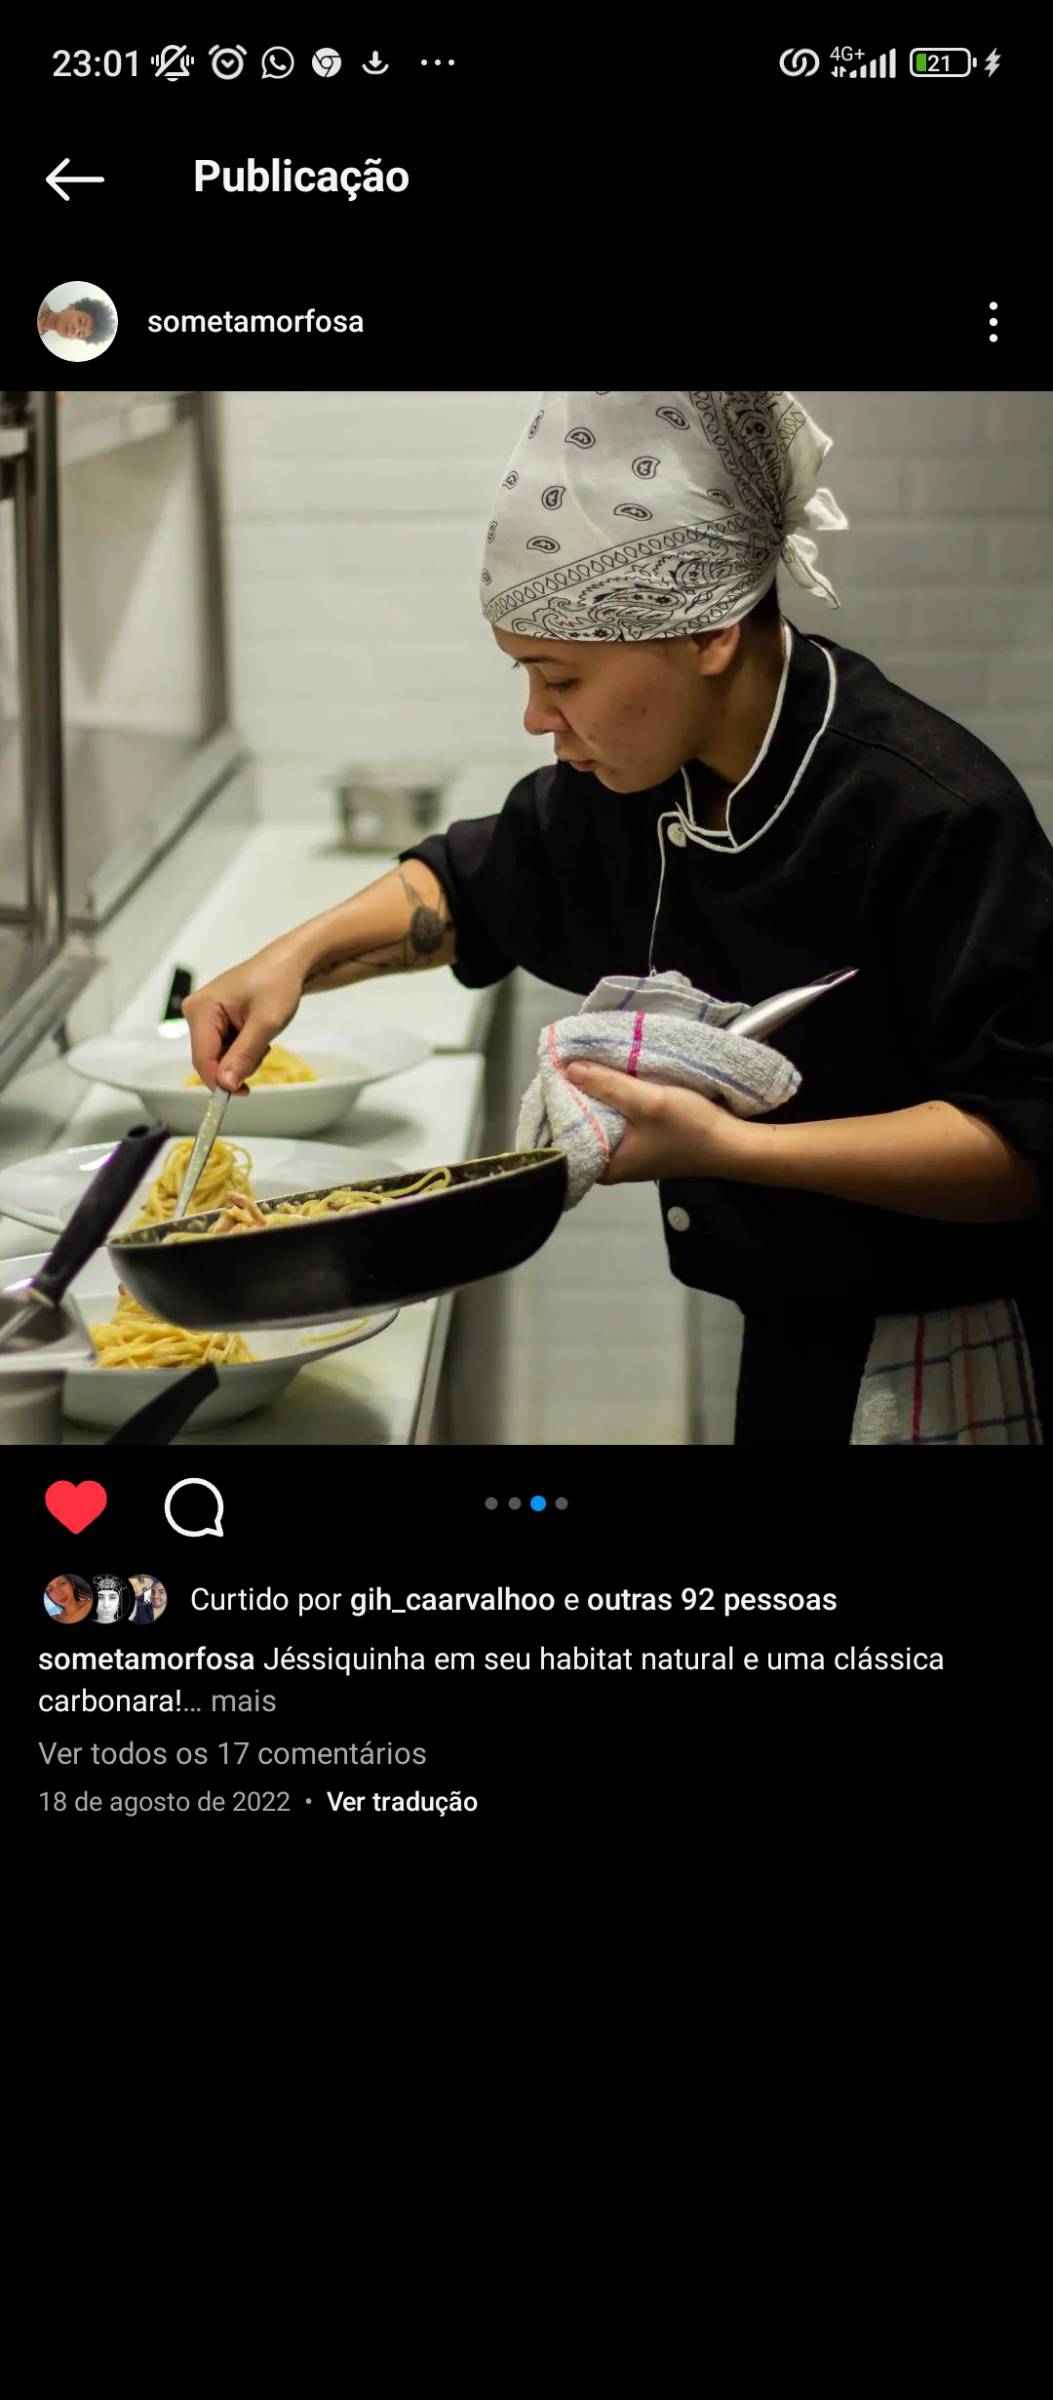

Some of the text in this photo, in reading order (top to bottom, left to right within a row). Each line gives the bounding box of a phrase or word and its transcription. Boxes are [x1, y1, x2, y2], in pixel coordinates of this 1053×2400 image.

[52, 49, 138, 78] 23:01
[829, 45, 866, 62] 4G+
[926, 54, 951, 73] 21
[194, 157, 410, 202] Publicação
[147, 307, 364, 334] sometamorfosa
[191, 1585, 838, 1617] Curtido por gih_caarvalhoo e outras 92 pessoas
[38, 1645, 944, 1677] sometamorfosa Jéssiquinha em seu habitat natural e uma clássica
[211, 1688, 277, 1713] mais
[38, 1740, 427, 1765] Ver todos os 17 comentários
[38, 1790, 291, 1817] 18 de agosto de 2022
[326, 1789, 479, 1818] Ver tradução
